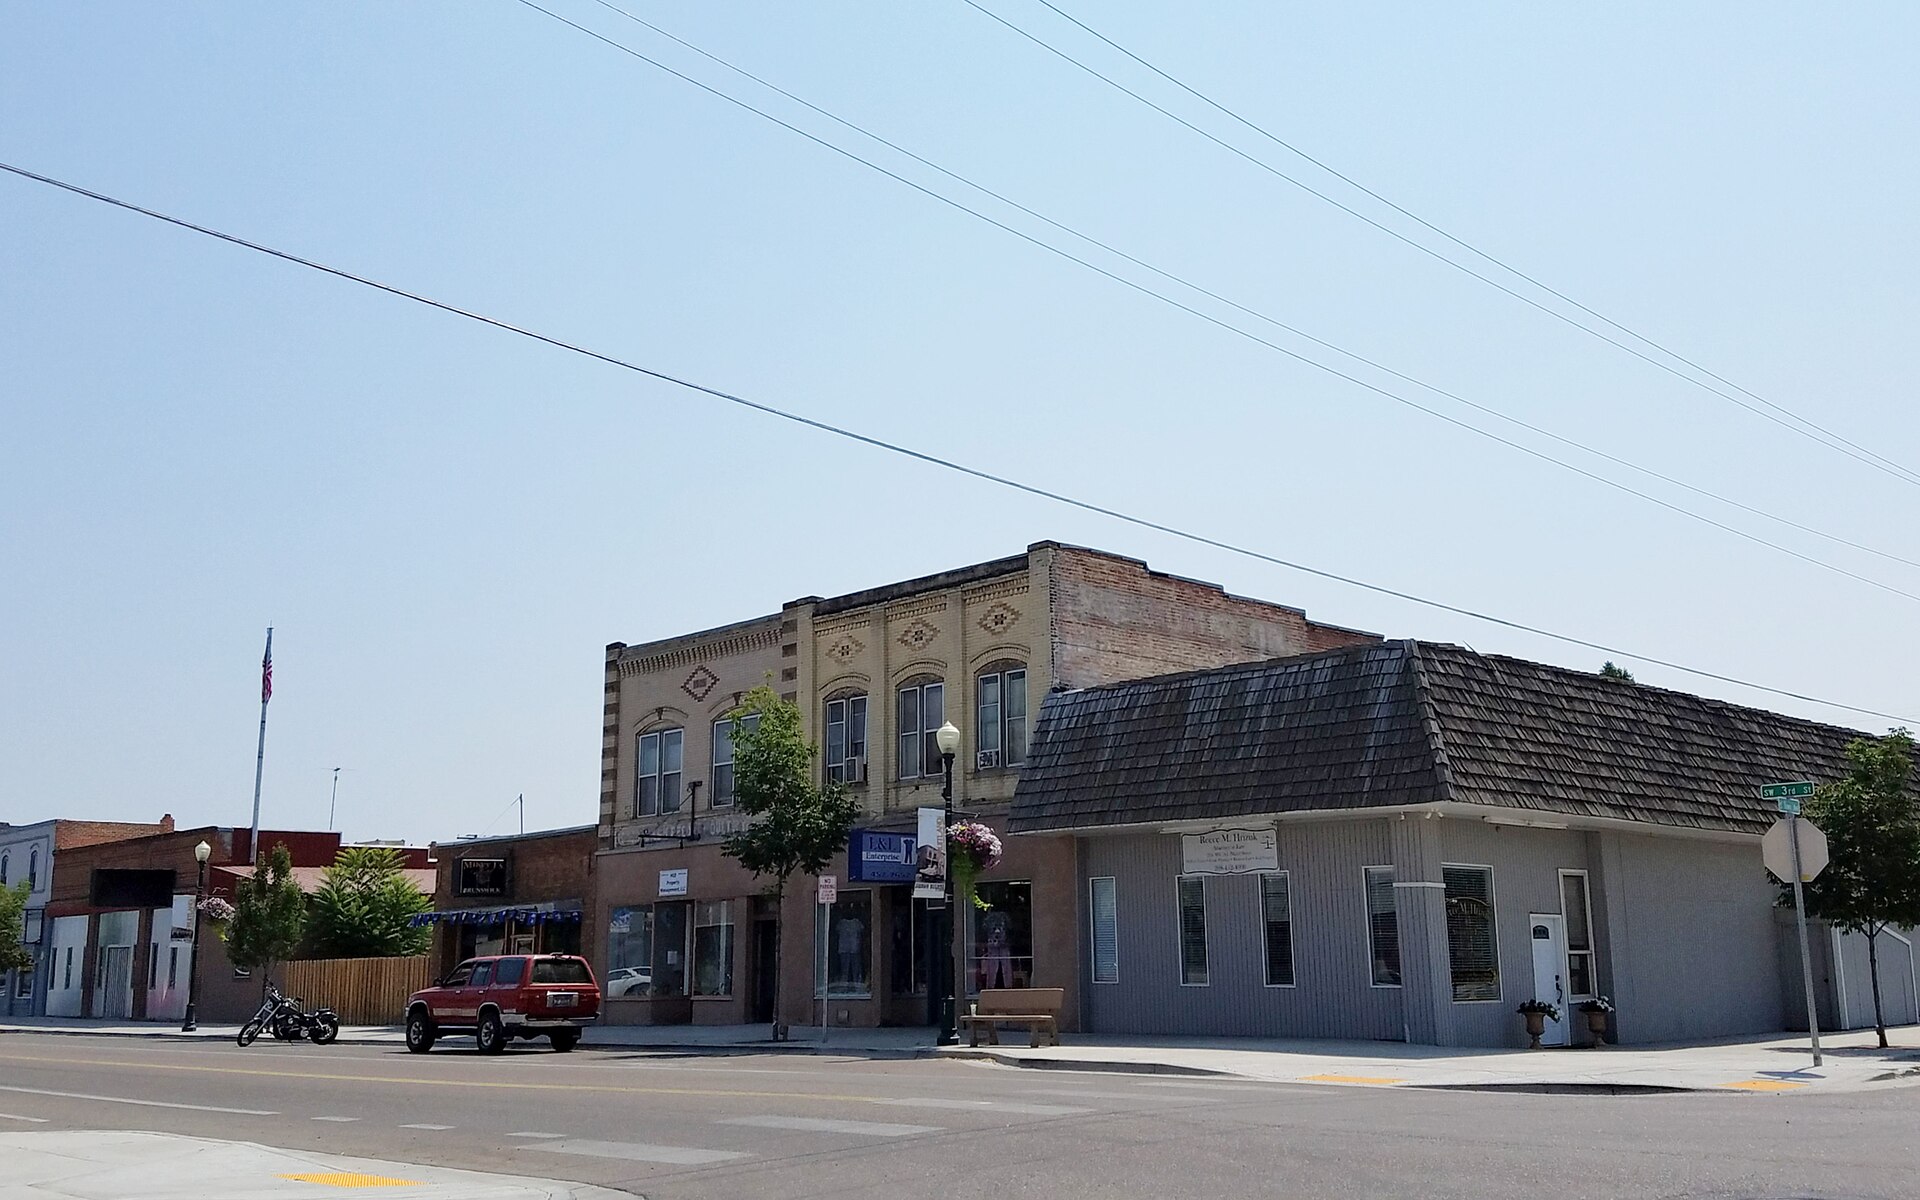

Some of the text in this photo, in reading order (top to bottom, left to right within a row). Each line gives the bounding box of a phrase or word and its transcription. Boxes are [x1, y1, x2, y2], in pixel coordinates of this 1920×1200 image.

[1763, 785, 1811, 797] SW 3rd St
[1222, 833, 1231, 842] M.
[868, 836, 898, 850] L&L
[865, 853, 900, 862] Enterprise
